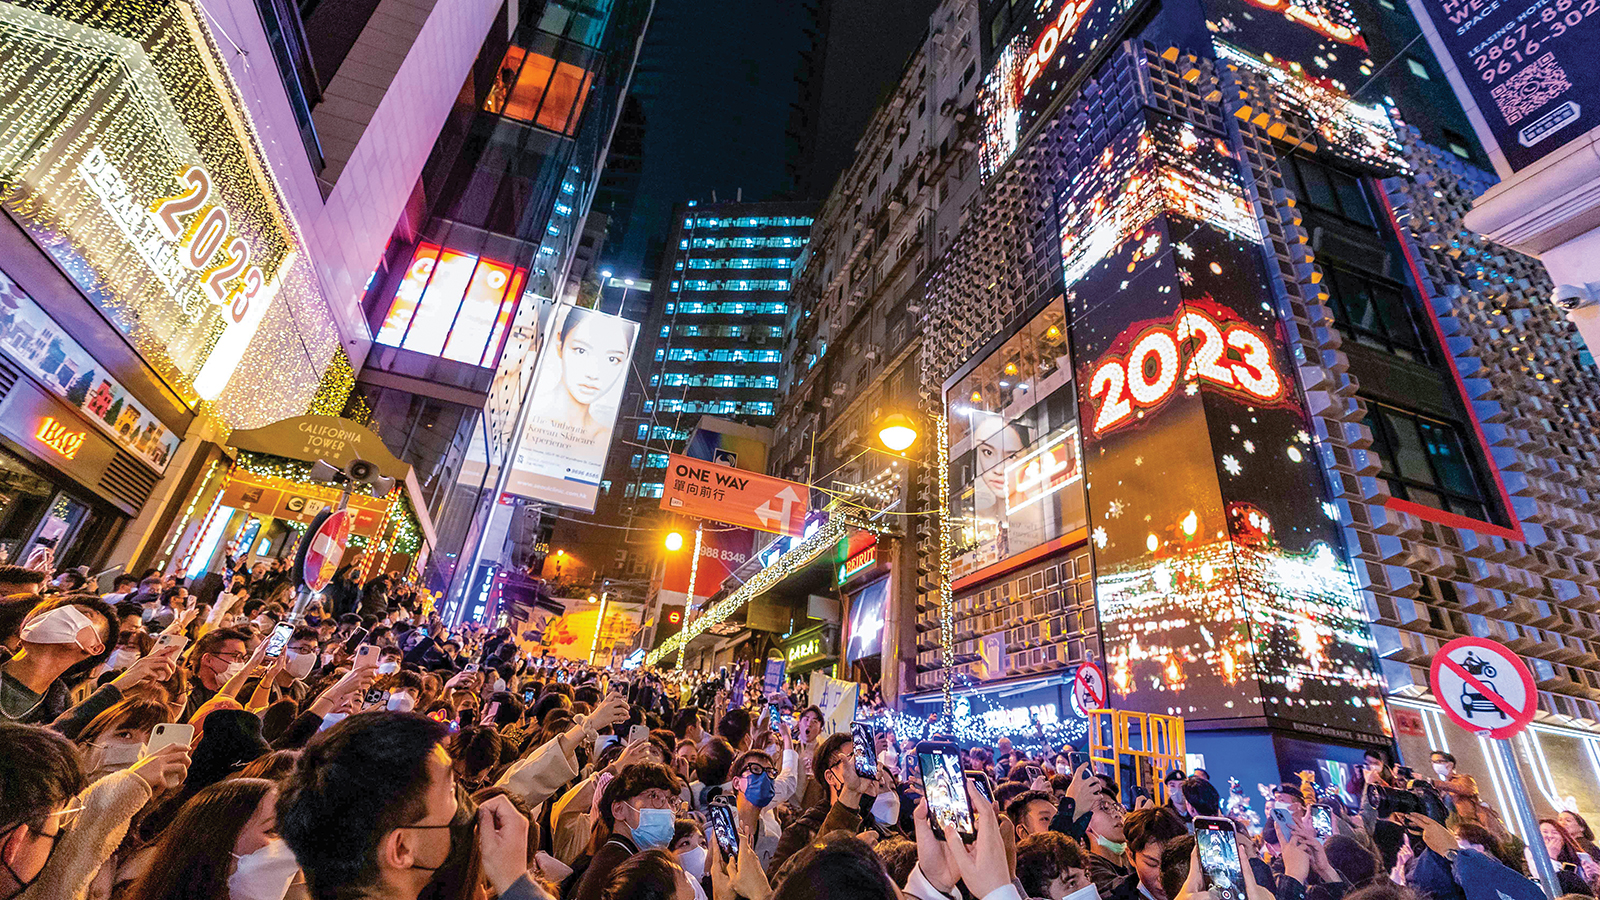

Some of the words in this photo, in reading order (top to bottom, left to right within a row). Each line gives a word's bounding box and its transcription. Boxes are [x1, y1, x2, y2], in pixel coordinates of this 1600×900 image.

[1456, 0, 1500, 36] SPACE
[1468, 21, 1516, 58] LEASING
[152, 165, 265, 325] 2023
[1088, 312, 1283, 433] 2023
[298, 422, 361, 443] CALIFORNIA
[527, 424, 559, 438] Korean
[560, 432, 595, 446] Skincare
[550, 419, 588, 435] Authentic
[307, 434, 346, 451] TOWER
[525, 432, 572, 449] Experience
[676, 464, 711, 483] ONE
[715, 472, 749, 491] WAY
[673, 478, 726, 502] 單向前行
[720, 550, 746, 563] 8348
[846, 546, 876, 575] BEIRUT
